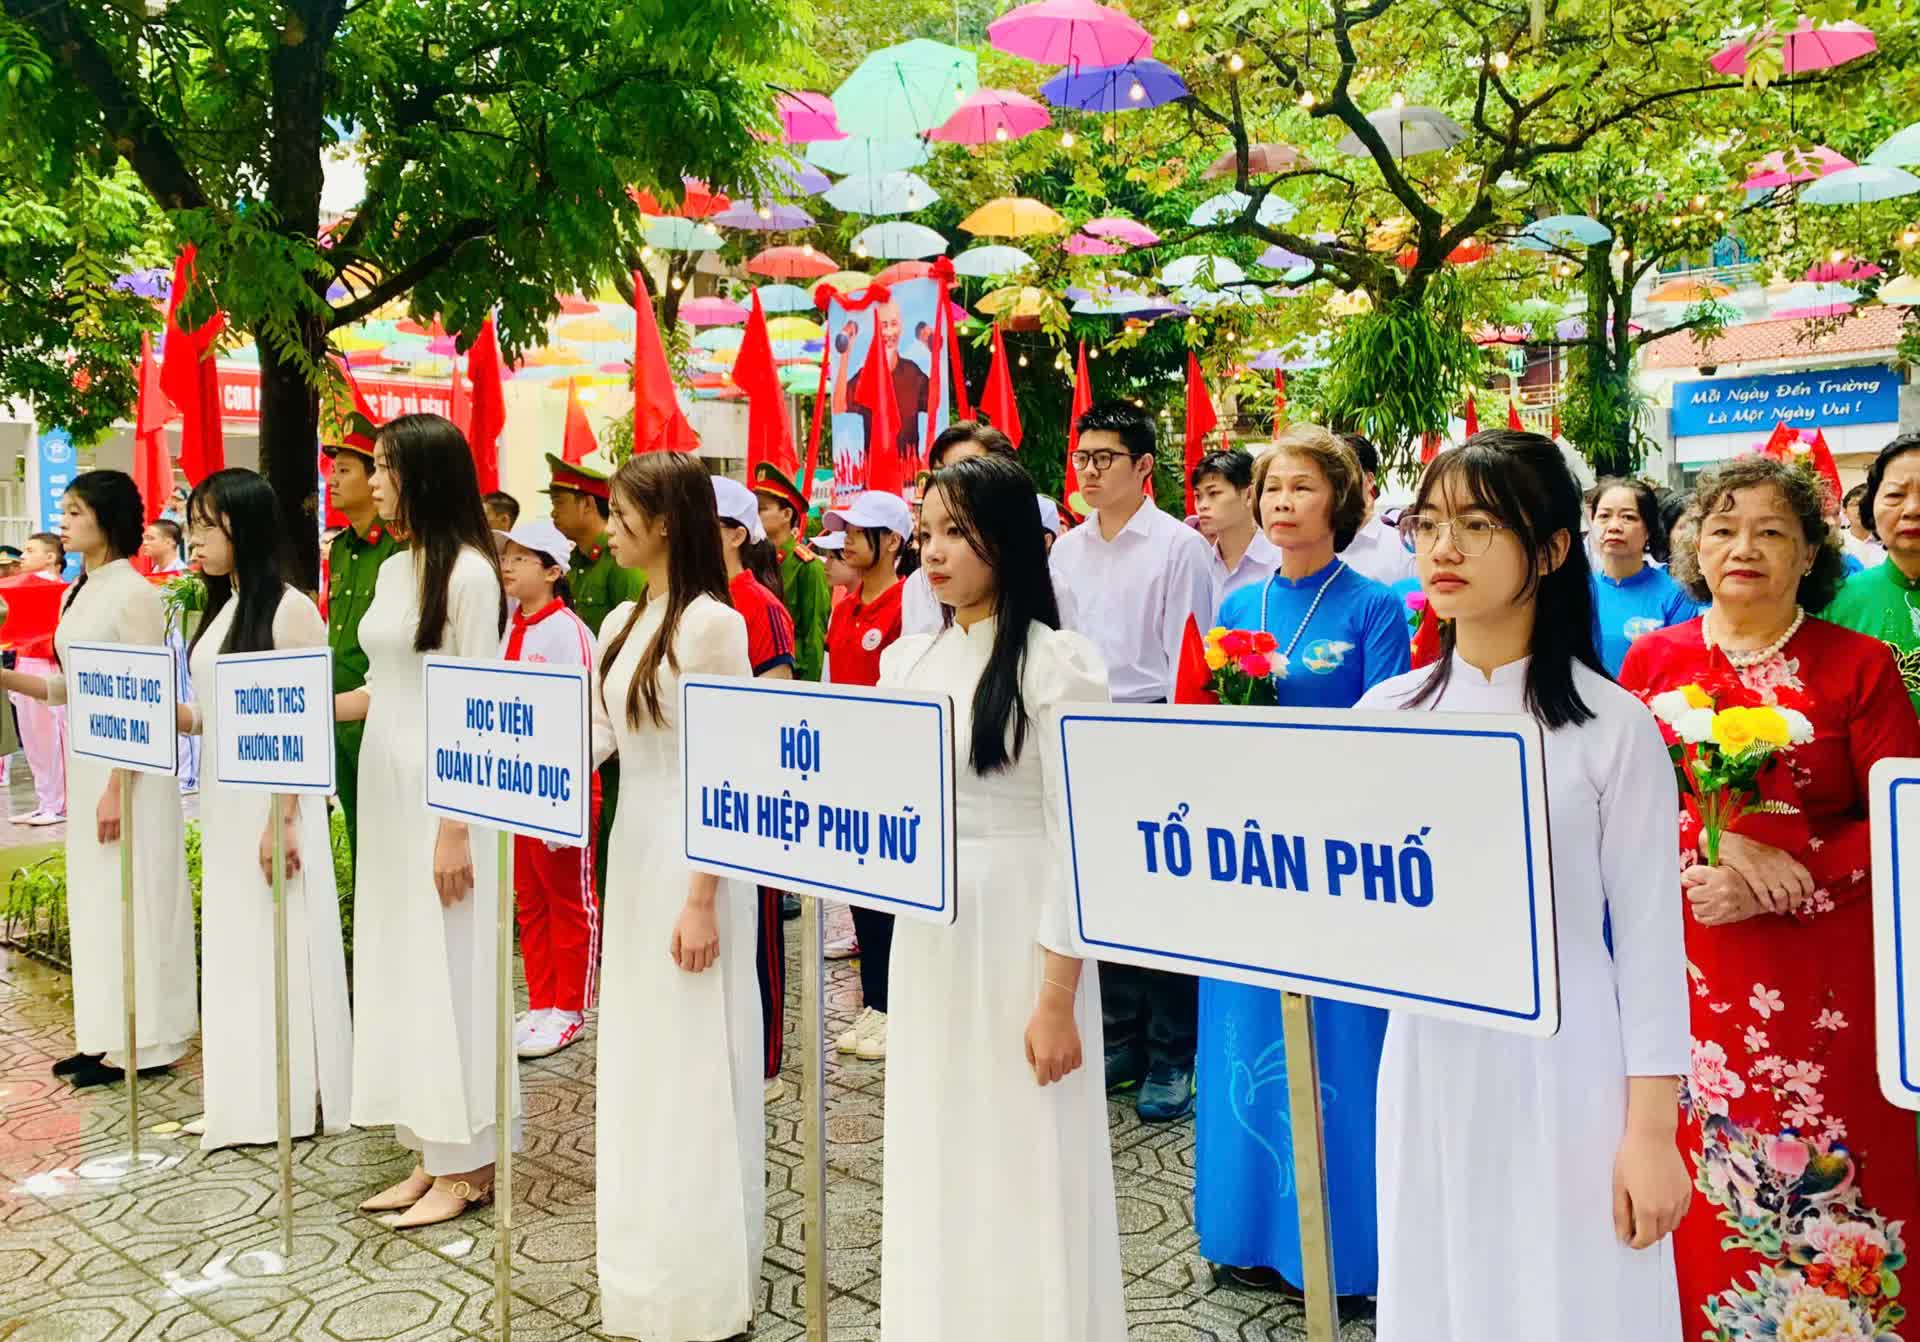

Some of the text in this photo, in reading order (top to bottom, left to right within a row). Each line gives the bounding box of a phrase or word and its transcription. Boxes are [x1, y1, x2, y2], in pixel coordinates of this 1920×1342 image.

[1691, 378, 1881, 405] Mỗi Ngày Đến Trường
[1707, 409, 1727, 425] Là
[1732, 408, 1765, 423] Một
[1770, 404, 1815, 423] Ngày
[78, 666, 161, 709] TRƯỜNG TIỂU HỌC
[234, 681, 305, 714] TRƯỜNG THCS
[89, 713, 150, 744] KHƯƠNG MAI
[466, 696, 534, 742] HỌC VIỆN
[282, 735, 304, 762] MAI
[780, 719, 820, 780] HỘI
[436, 740, 571, 807] QUẢN LÝ GIÁO DỤC
[701, 781, 921, 865] LIÊN HIỆP PHỤ NỮ
[1137, 802, 1434, 908] TỔ DÂN PHỐ
